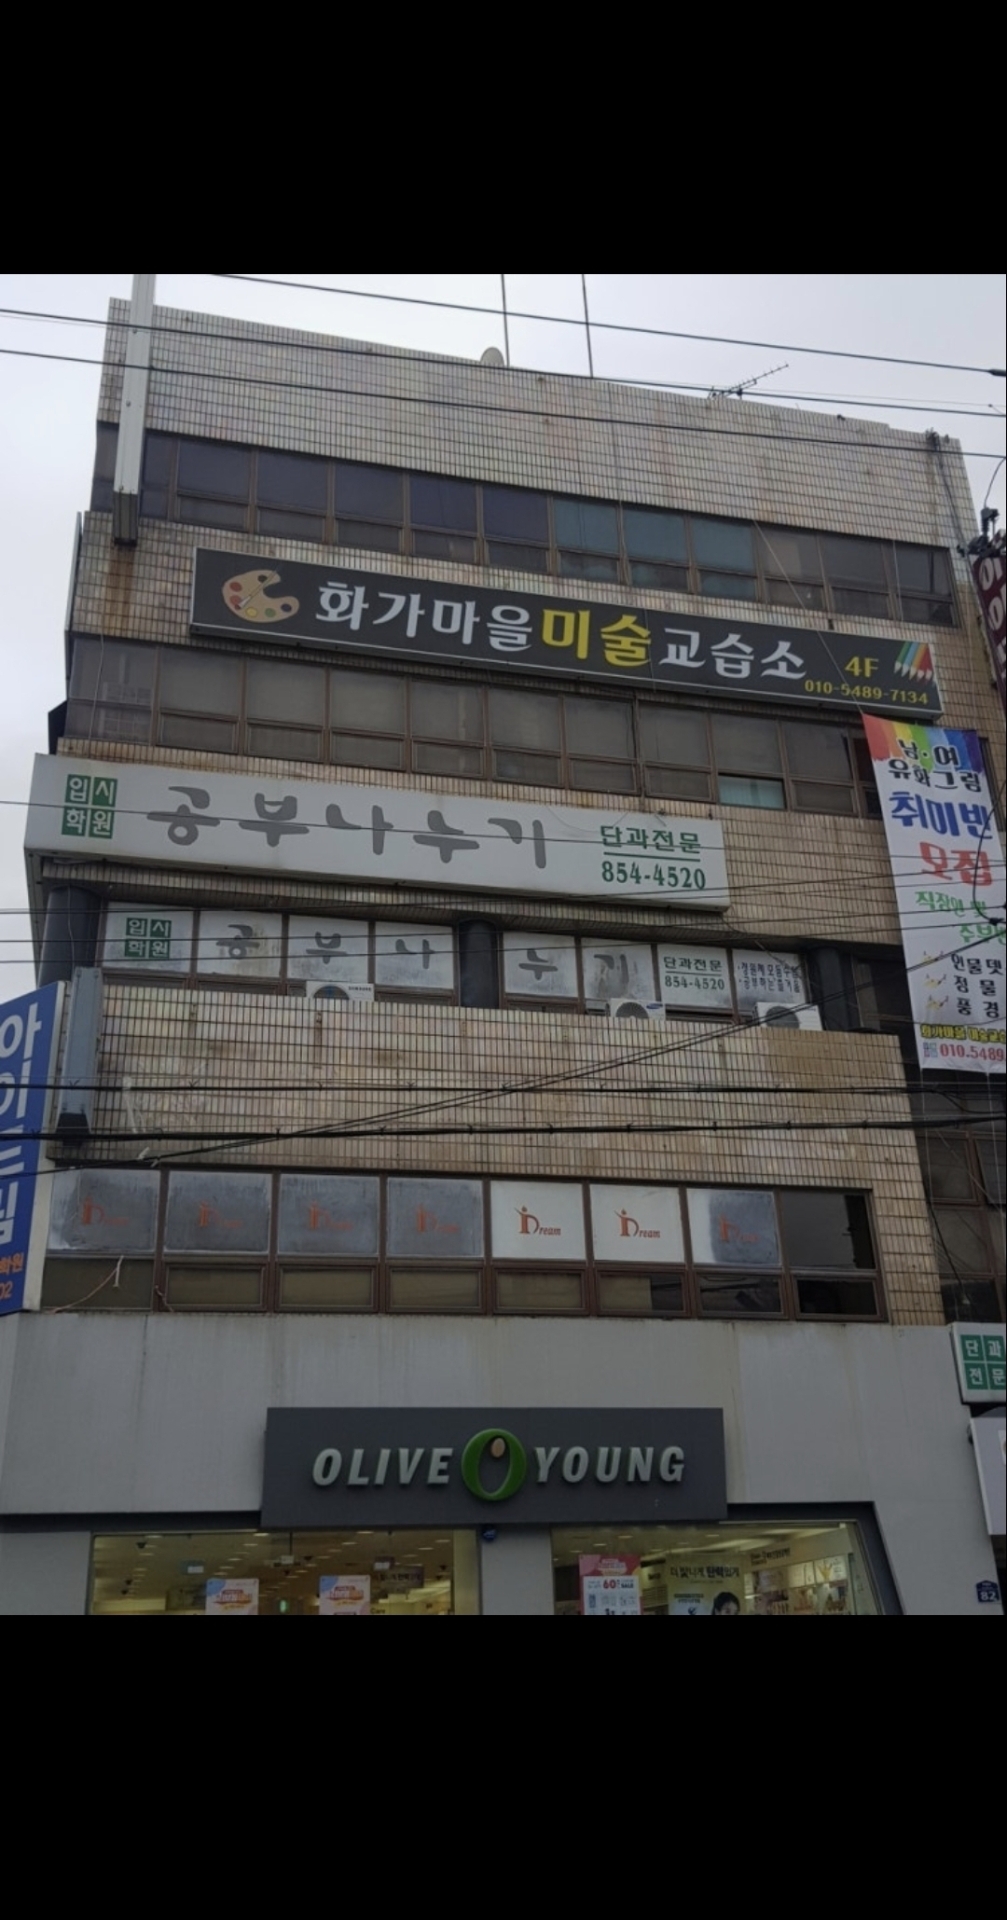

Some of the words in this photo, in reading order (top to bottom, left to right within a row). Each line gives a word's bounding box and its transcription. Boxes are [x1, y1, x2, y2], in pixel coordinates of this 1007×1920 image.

[845, 656, 879, 678] 4F
[804, 680, 929, 705] 010-5489-7134
[888, 759, 982, 792] 유화그림
[68, 776, 116, 806] 입시
[65, 807, 113, 837] 학원
[146, 785, 548, 870] 공부나누기
[889, 791, 993, 839] 취미반
[600, 824, 701, 854] 단과전문
[601, 860, 706, 891] 854-4520
[919, 842, 993, 887] 모집
[915, 891, 966, 918] 직장인
[128, 919, 169, 937] 입시
[127, 940, 168, 957] 학원
[663, 956, 722, 972] 단과전문
[951, 953, 1006, 976] 인물뎃
[665, 975, 725, 990] 854-4520
[965, 1340, 1002, 1358] 단과
[969, 1367, 1006, 1386] 전문
[312, 1447, 454, 1487] OLIVE
[534, 1446, 686, 1485] YOUNG
[603, 1579, 616, 1589] 60
[980, 1591, 998, 1601] 82
